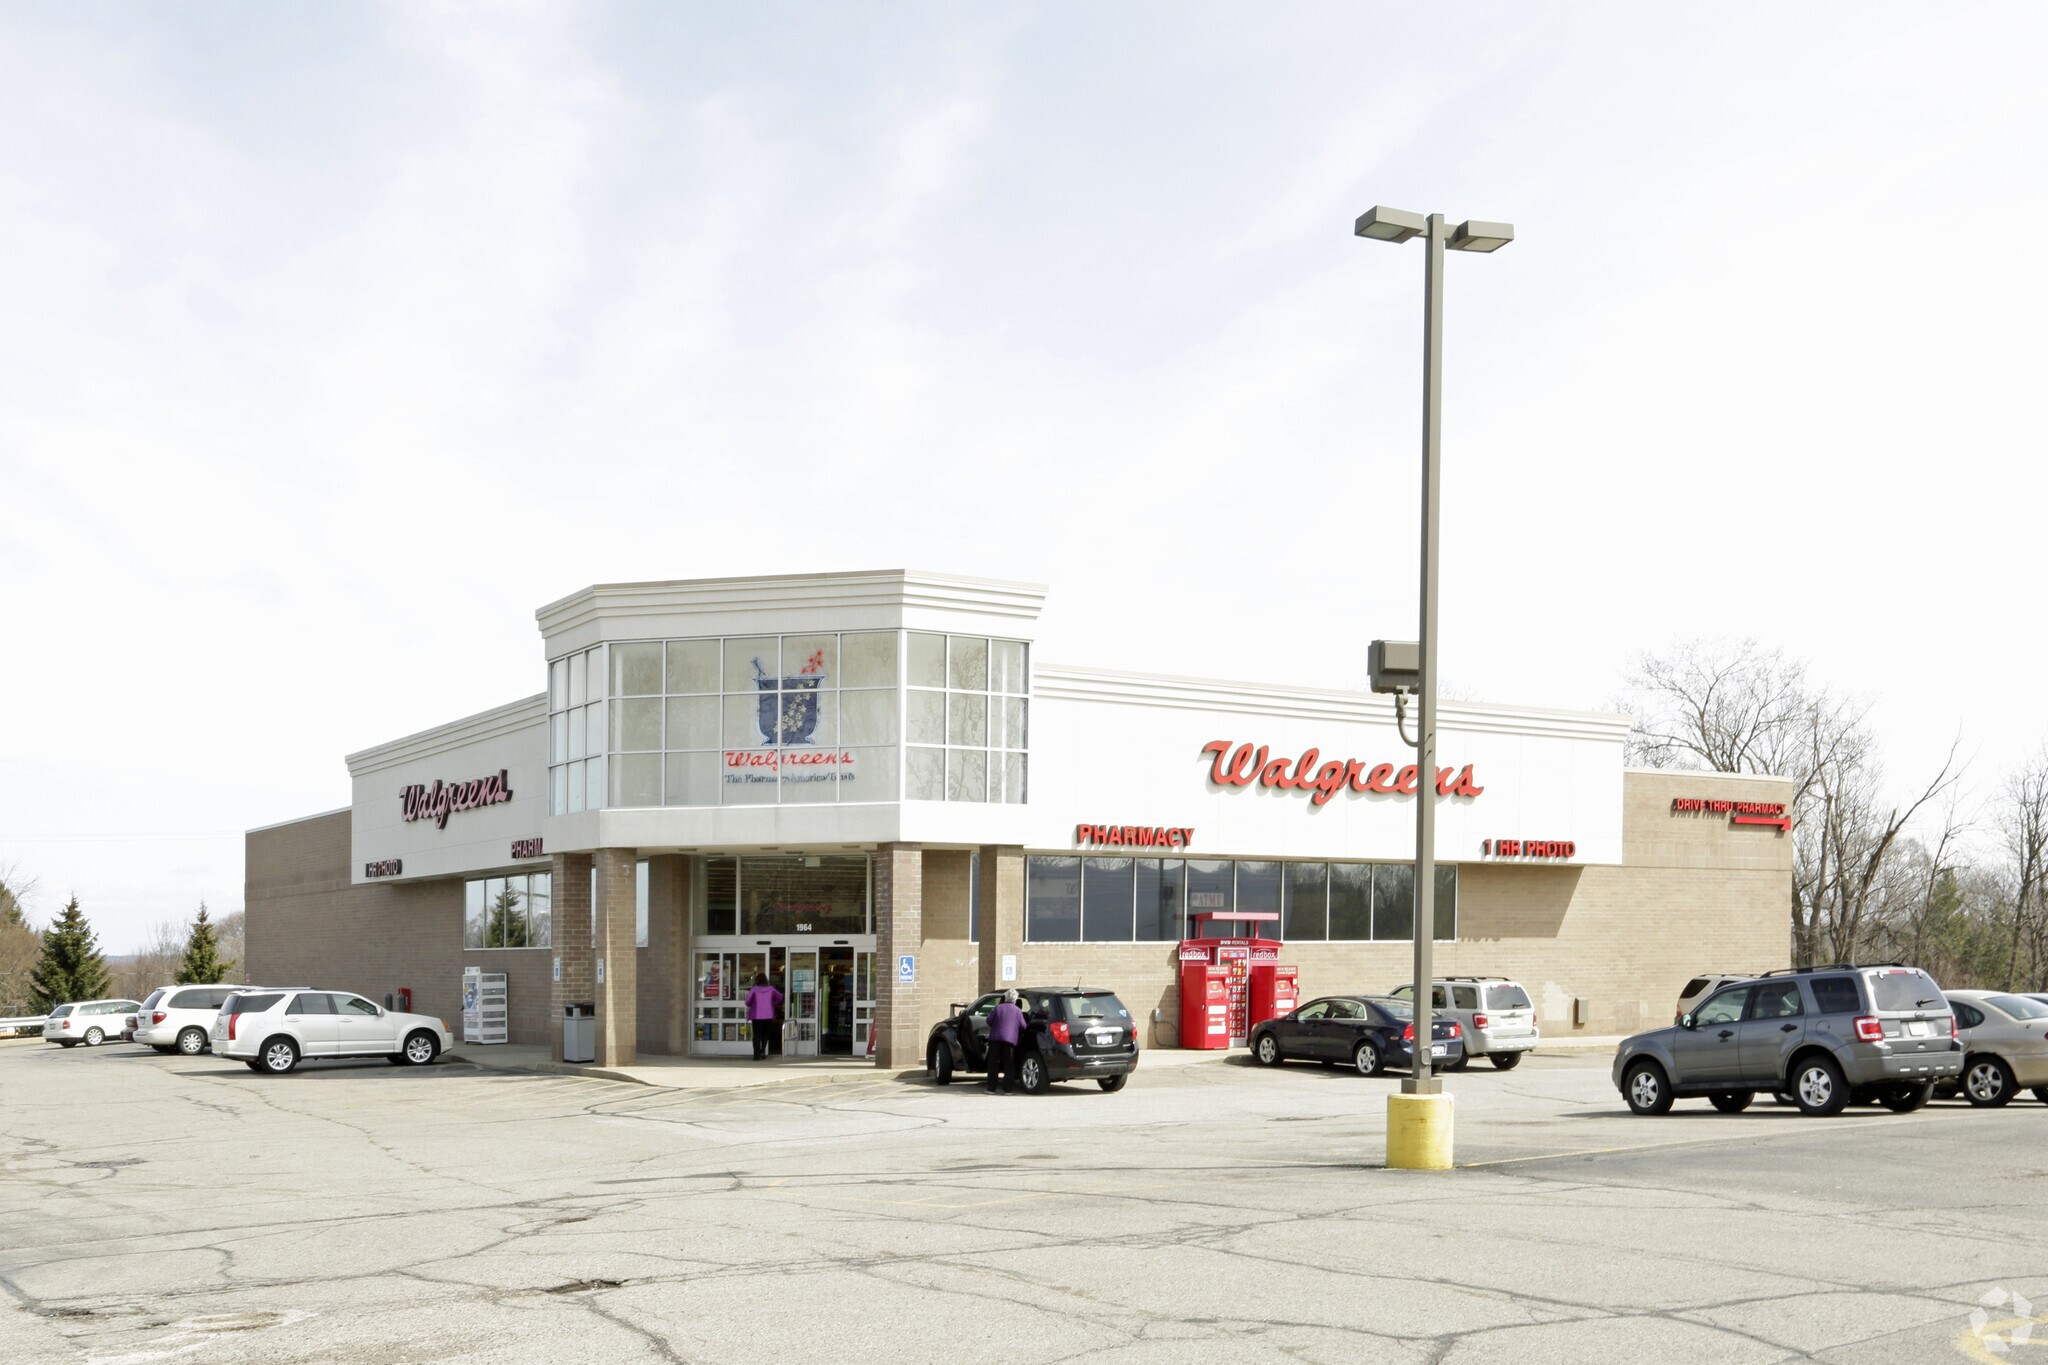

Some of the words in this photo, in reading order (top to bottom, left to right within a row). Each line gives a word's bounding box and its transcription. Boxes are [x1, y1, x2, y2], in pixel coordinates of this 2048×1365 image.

[725, 751, 855, 771] Walgreens
[1201, 739, 1485, 806] Walgreens
[399, 769, 513, 829] Walgreens
[1674, 798, 1706, 811] DRIVE
[1706, 800, 1733, 812] THRU
[1735, 802, 1787, 815] PHARMACY
[1077, 823, 1194, 847] PHARMACY
[1483, 838, 1492, 856] 1
[1497, 839, 1521, 856] HR
[1523, 840, 1576, 857] PHOTO
